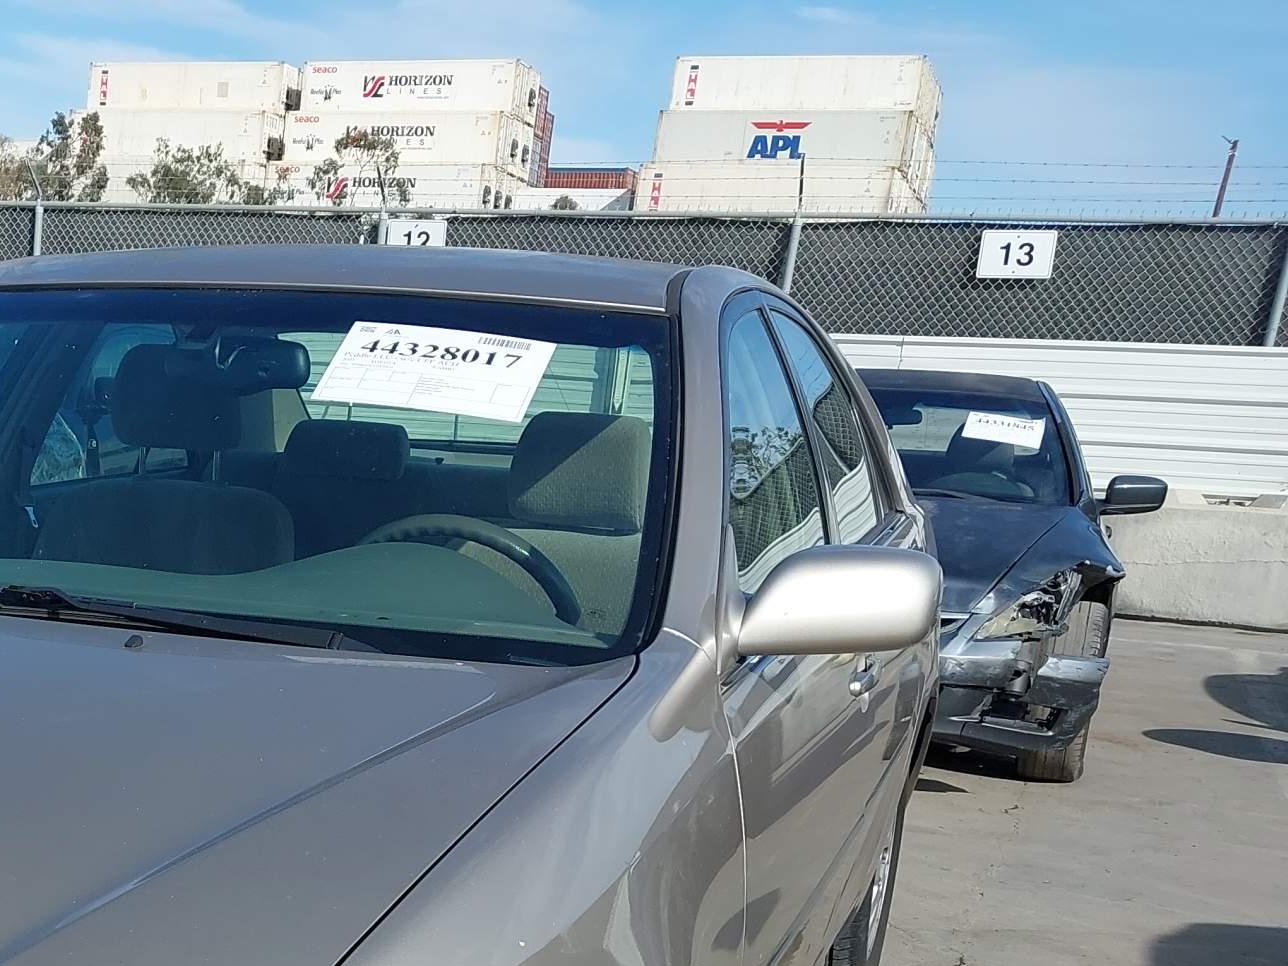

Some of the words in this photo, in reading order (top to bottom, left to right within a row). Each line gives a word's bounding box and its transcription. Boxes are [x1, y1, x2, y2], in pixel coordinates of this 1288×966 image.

[312, 66, 338, 74] seaco
[388, 75, 454, 86] HORIZON
[386, 87, 442, 95] LINES
[294, 115, 320, 124] seaco
[371, 126, 436, 137] HORIZON
[746, 135, 803, 160] APL
[403, 230, 430, 246] 12
[999, 241, 1035, 267] 13
[360, 338, 524, 369] 44328017
